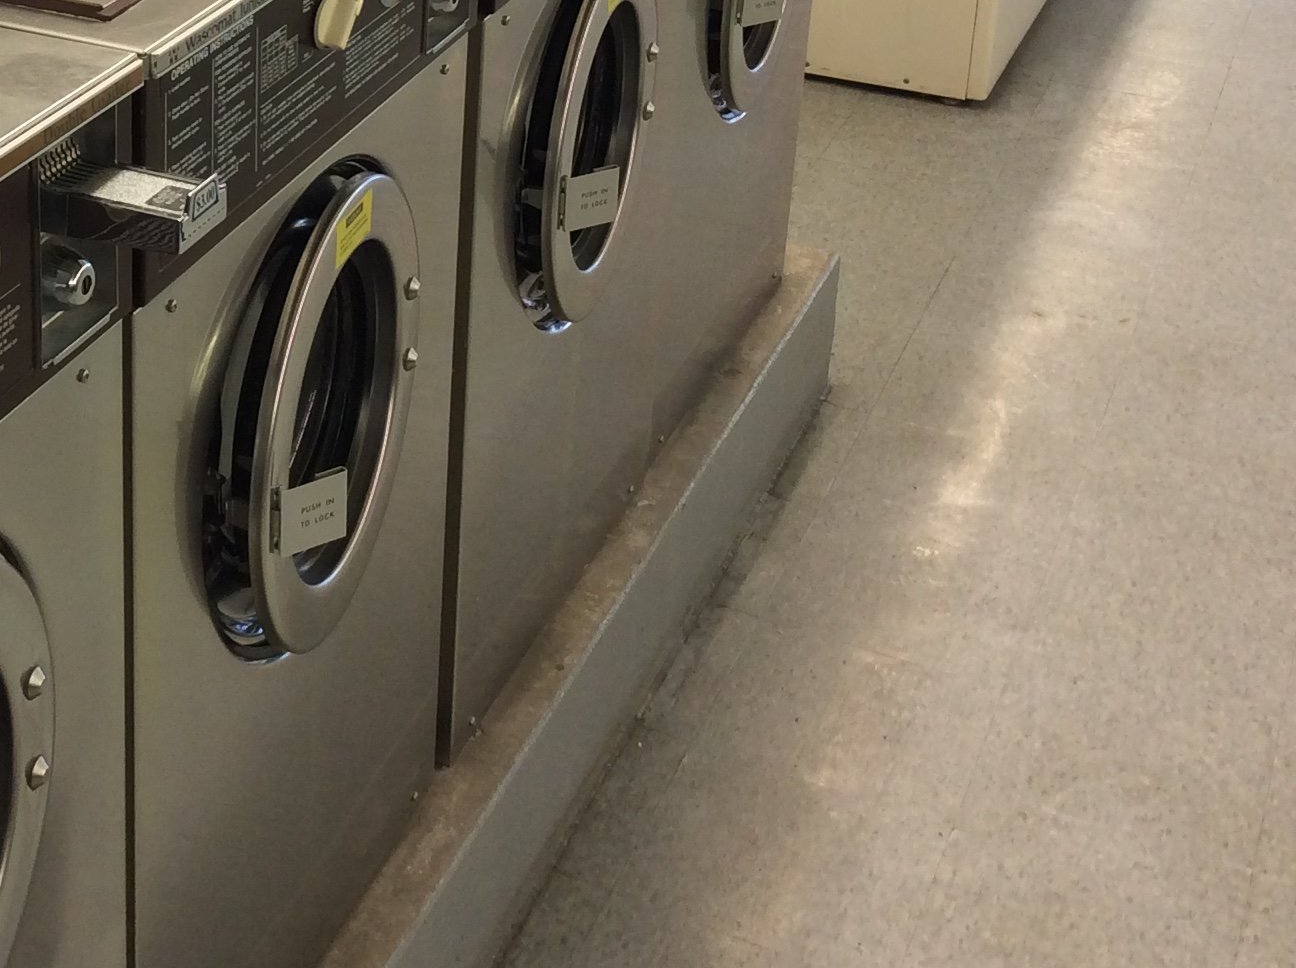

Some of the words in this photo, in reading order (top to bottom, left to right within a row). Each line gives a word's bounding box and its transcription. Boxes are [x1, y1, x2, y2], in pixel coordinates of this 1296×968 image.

[171, 46, 209, 81] OPERATING
[210, 14, 254, 55] INSTRUCTIONS
[301, 502, 321, 515] PUSH
[325, 497, 335, 506] IN
[300, 519, 310, 528] TO
[314, 512, 335, 524] LOCK
